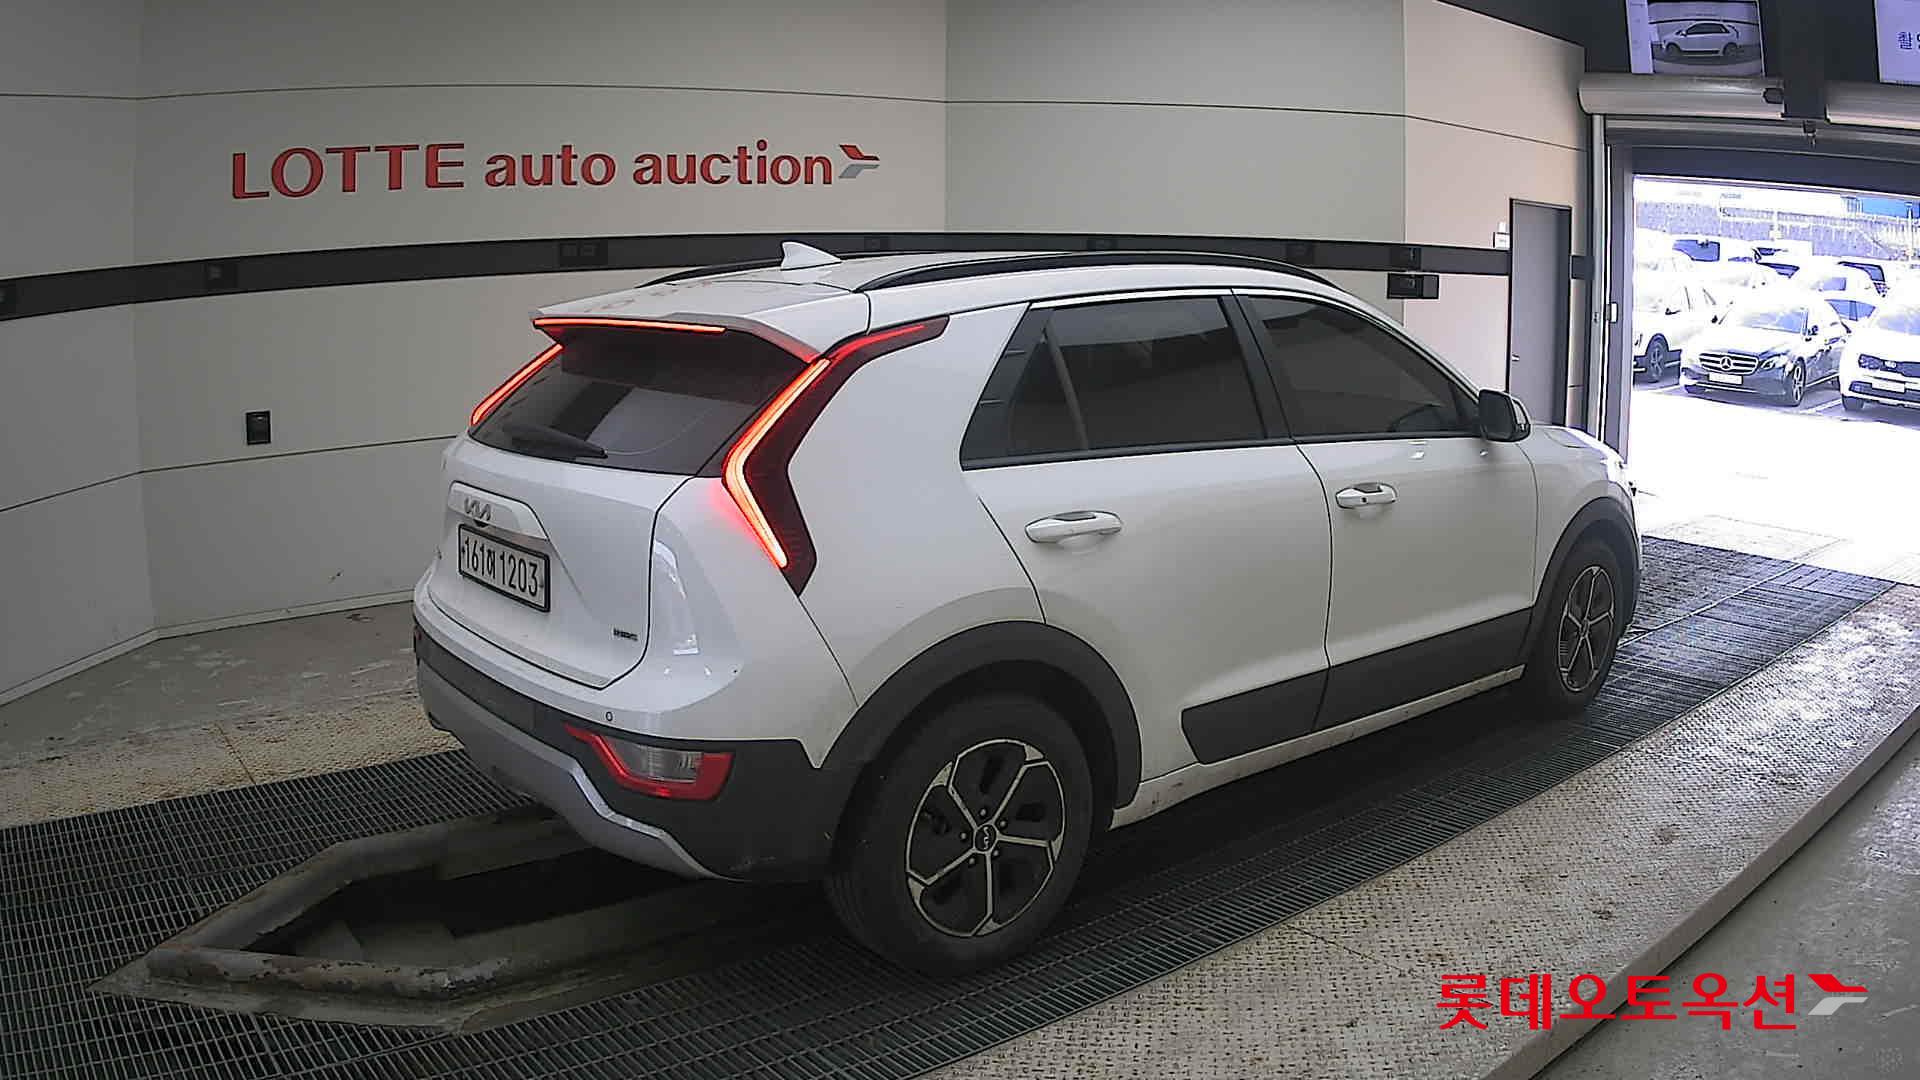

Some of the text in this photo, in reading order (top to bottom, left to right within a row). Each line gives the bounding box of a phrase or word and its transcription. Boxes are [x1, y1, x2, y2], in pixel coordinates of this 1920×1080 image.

[232, 138, 833, 199] LOTTE auto auction
[500, 550, 538, 597] 1203
